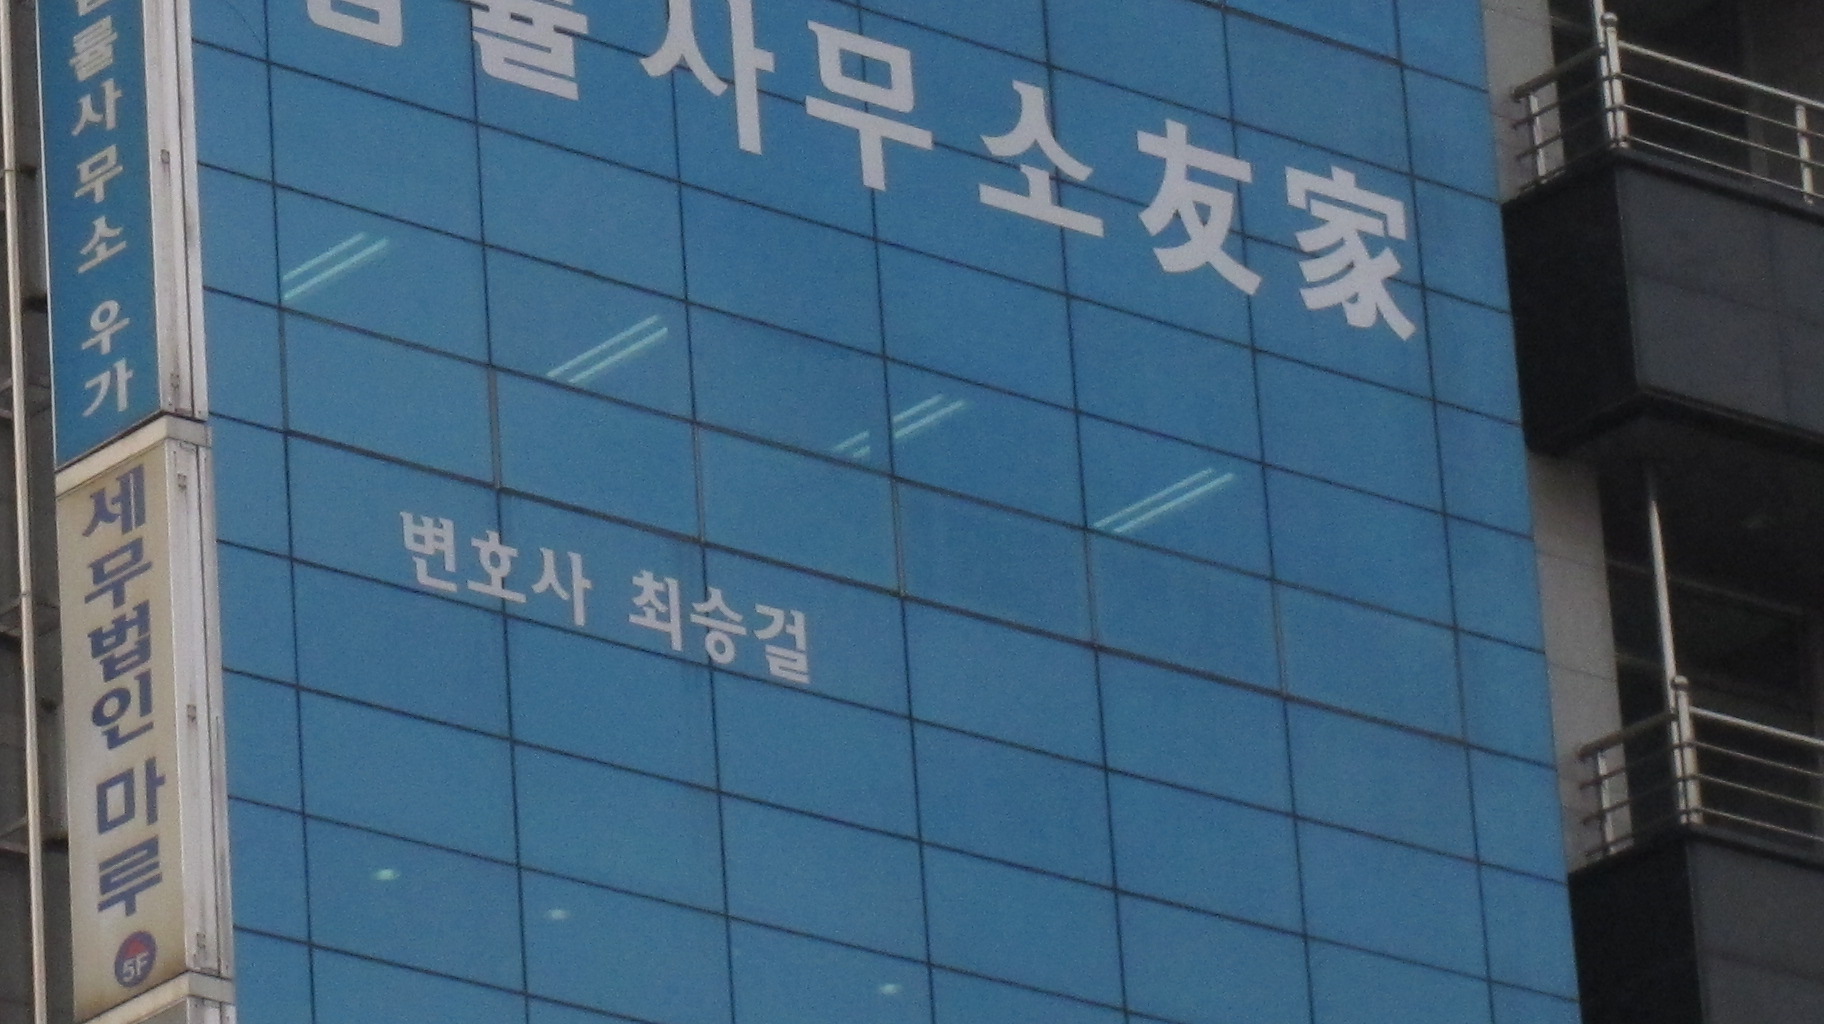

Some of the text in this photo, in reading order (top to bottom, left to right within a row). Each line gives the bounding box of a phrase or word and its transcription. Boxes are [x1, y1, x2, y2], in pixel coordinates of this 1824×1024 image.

[400, 511, 811, 684] 변호사 최승걸
[122, 951, 150, 983] 5F
